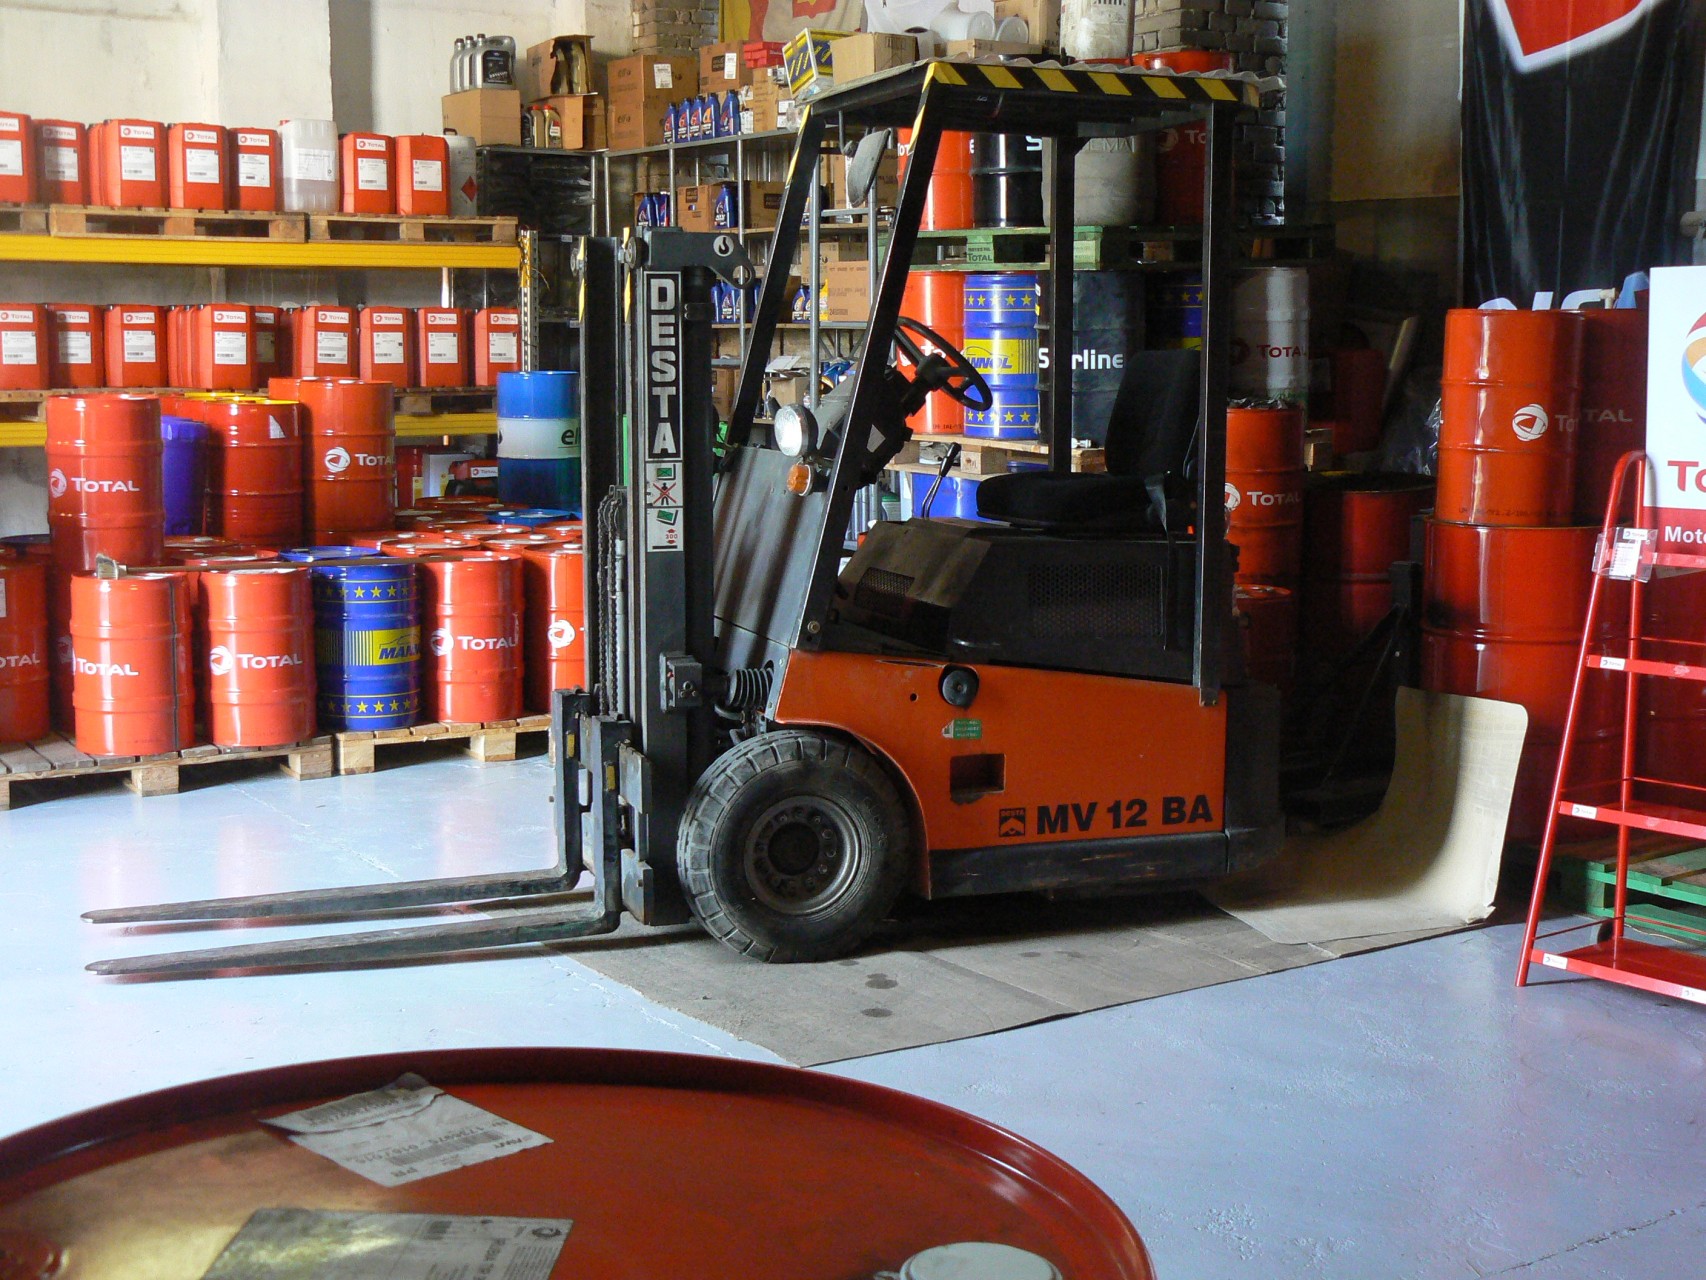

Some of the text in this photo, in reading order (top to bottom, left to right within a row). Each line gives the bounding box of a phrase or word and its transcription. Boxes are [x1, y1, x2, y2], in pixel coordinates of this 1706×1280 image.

[967, 253, 993, 262] TOTAL
[650, 278, 677, 454] DESTA
[1038, 347, 1124, 370] Srline
[71, 477, 140, 493] TOTAL
[458, 634, 517, 650] TOTAL
[77, 657, 139, 676] TOTAL
[236, 652, 303, 670] TOTAL
[1036, 793, 1214, 836] MV 12 BA
